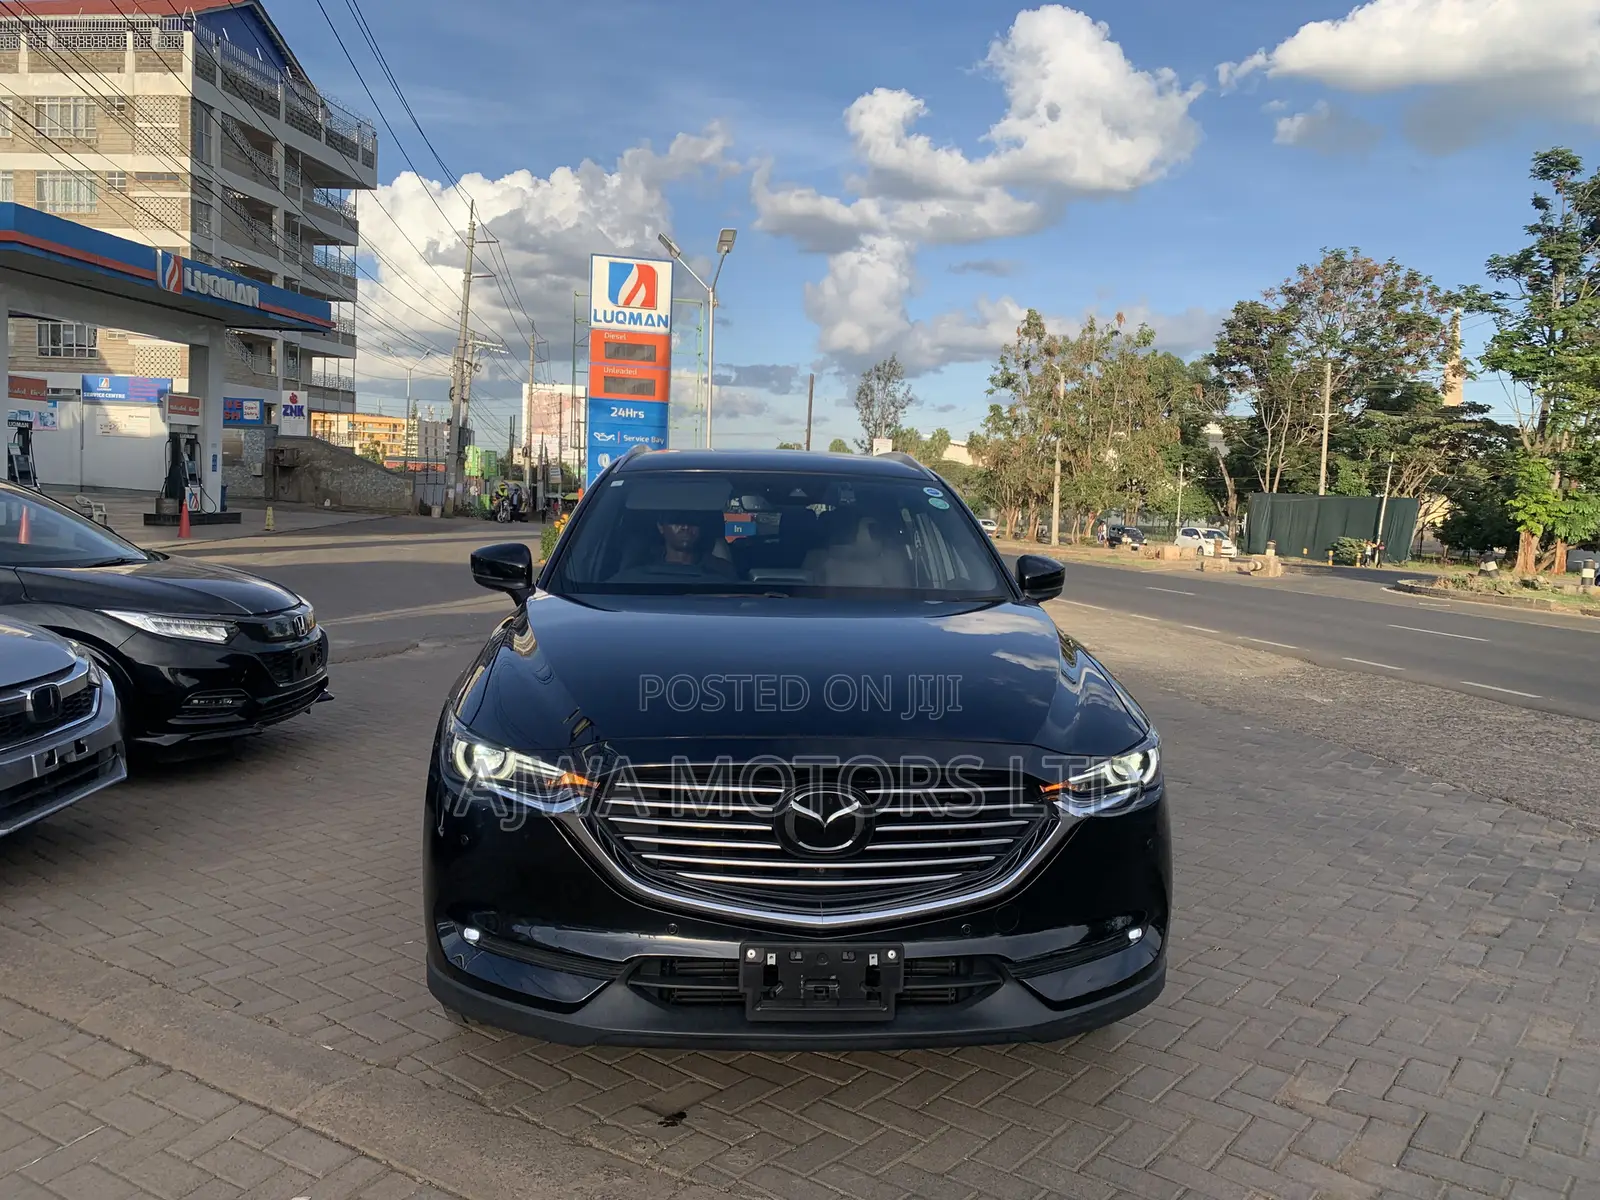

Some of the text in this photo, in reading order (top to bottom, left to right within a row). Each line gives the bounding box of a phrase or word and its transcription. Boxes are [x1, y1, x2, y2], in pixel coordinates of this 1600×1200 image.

[184, 266, 260, 308] LUQMAN
[593, 309, 669, 328] LUQMAN
[604, 332, 627, 340] Diesel
[604, 366, 638, 375] Unleaded
[282, 405, 305, 417] ZNK
[610, 406, 645, 419] 24Hrs
[623, 434, 665, 445] Service Bay
